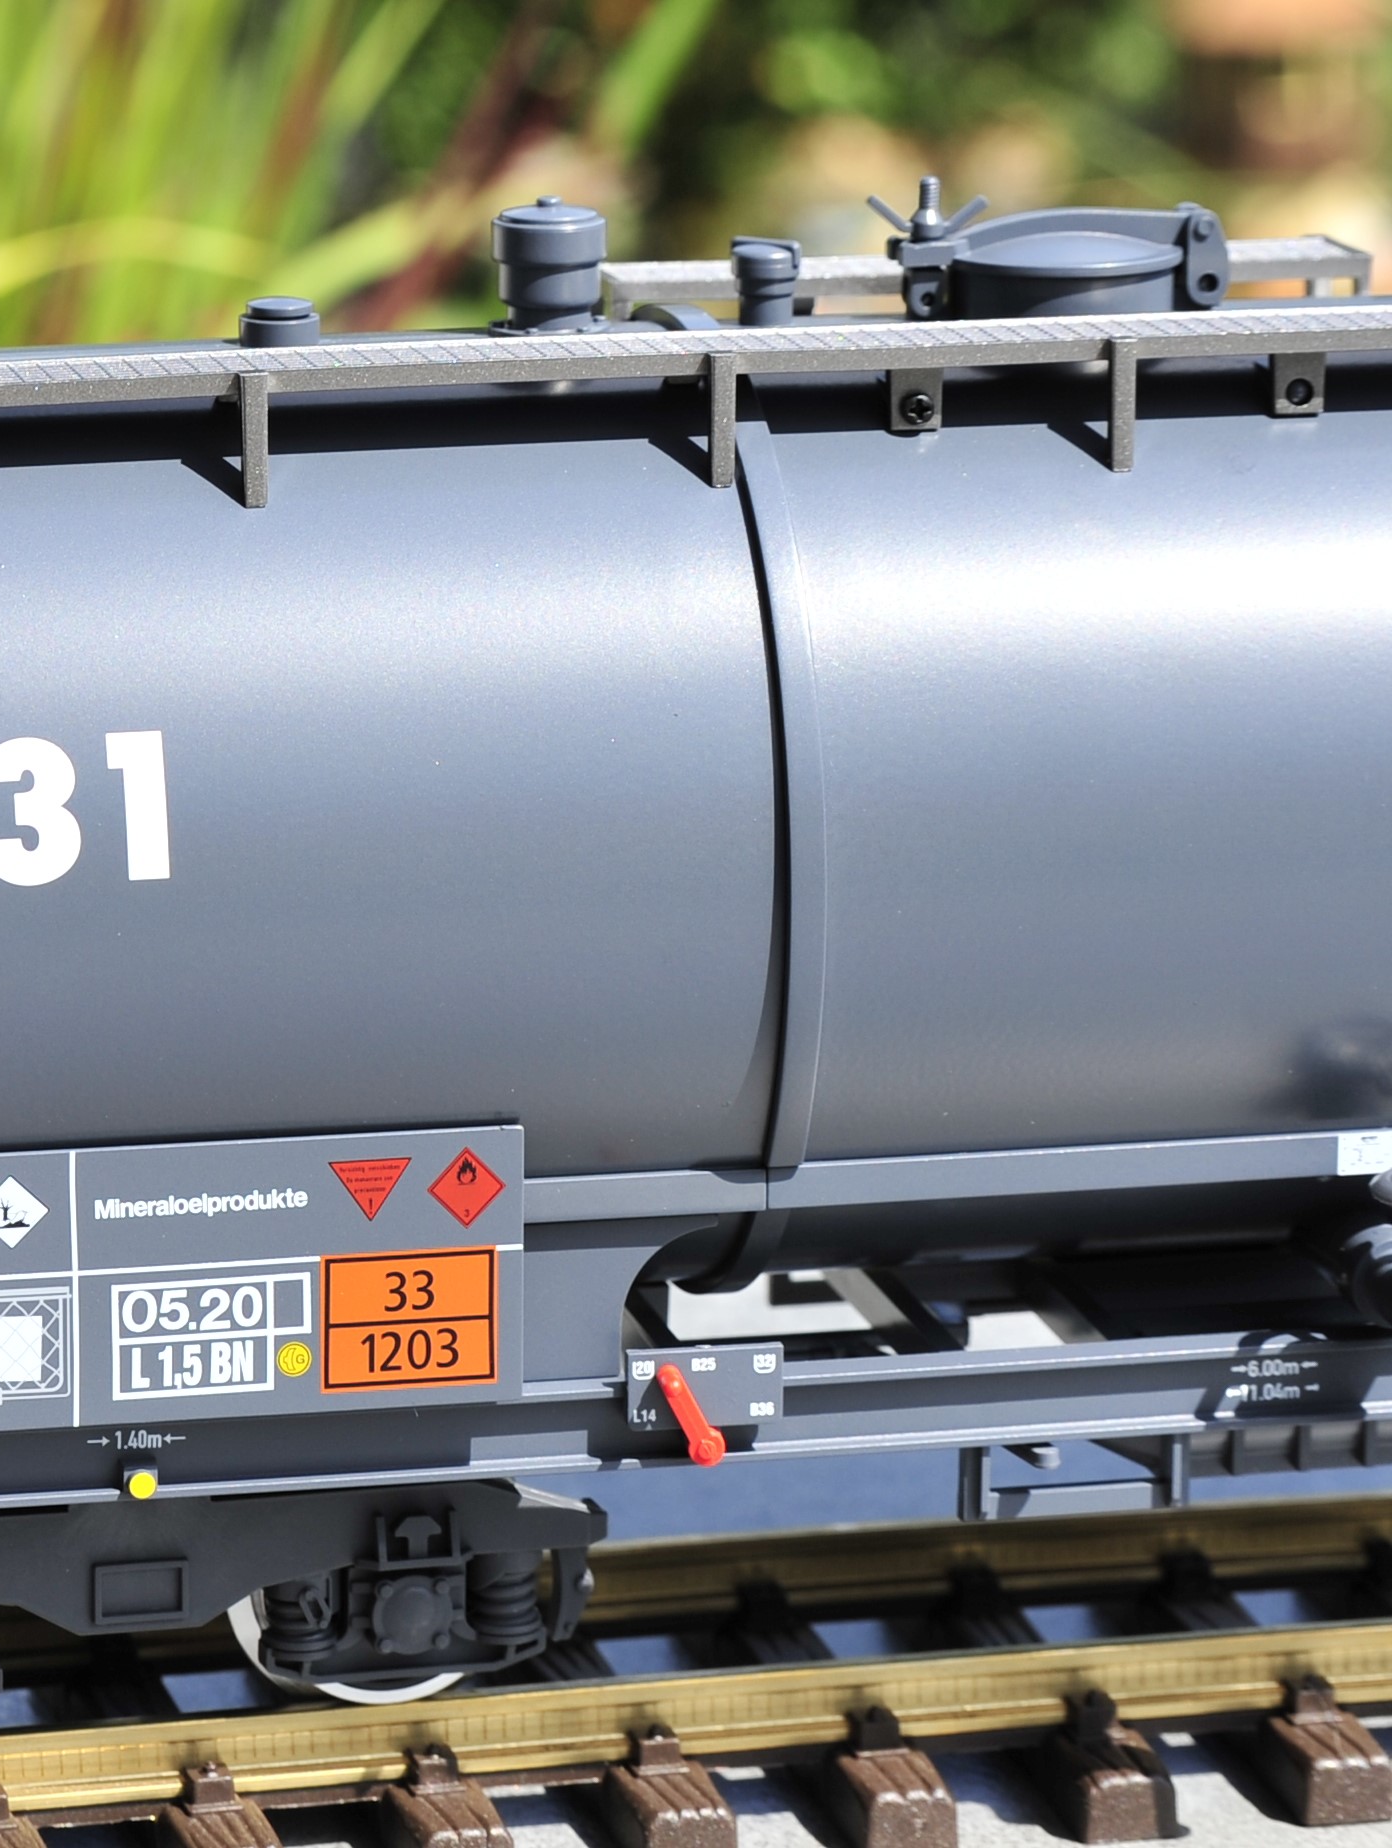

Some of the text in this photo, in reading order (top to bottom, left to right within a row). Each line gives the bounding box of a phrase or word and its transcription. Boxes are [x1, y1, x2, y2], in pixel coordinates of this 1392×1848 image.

[94, 1187, 309, 1220] Mineraloelprodukte
[463, 1208, 471, 1218] 3
[384, 1269, 435, 1313] 33
[360, 1327, 460, 1374] 1203
[131, 1339, 254, 1389] L 1,5 BN
[691, 1357, 717, 1372] B25
[1247, 1359, 1300, 1378] 6.00m
[633, 1408, 657, 1423] L14
[114, 1429, 163, 1450] 1.40m
